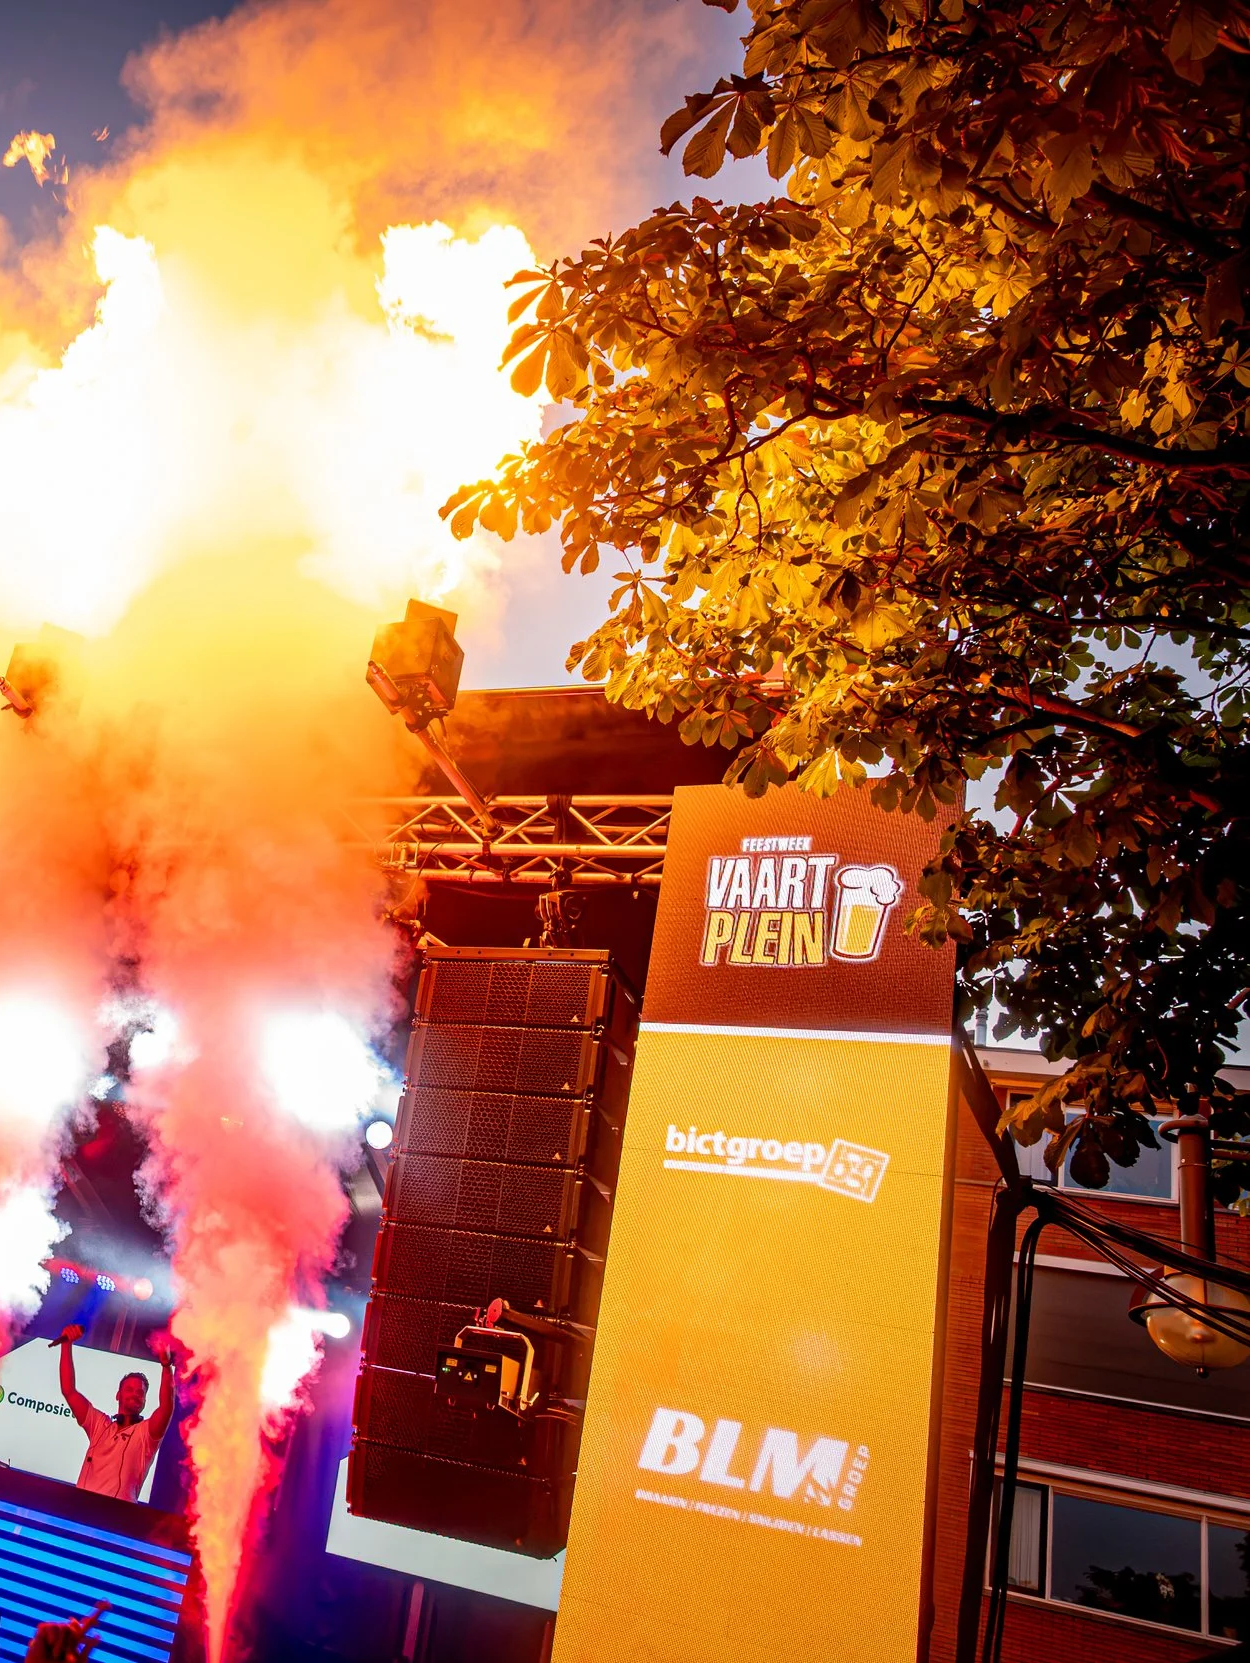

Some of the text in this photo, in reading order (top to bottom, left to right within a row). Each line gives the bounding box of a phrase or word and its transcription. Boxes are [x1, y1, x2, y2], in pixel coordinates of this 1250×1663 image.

[741, 836, 813, 852] FEESTWEEK
[706, 855, 837, 911] VAART
[701, 910, 827, 966] PLEIN
[664, 1123, 827, 1172] bictgroep
[7, 1391, 76, 1419] Composie
[636, 1406, 849, 1503] BLM
[837, 1444, 871, 1511] GROEP
